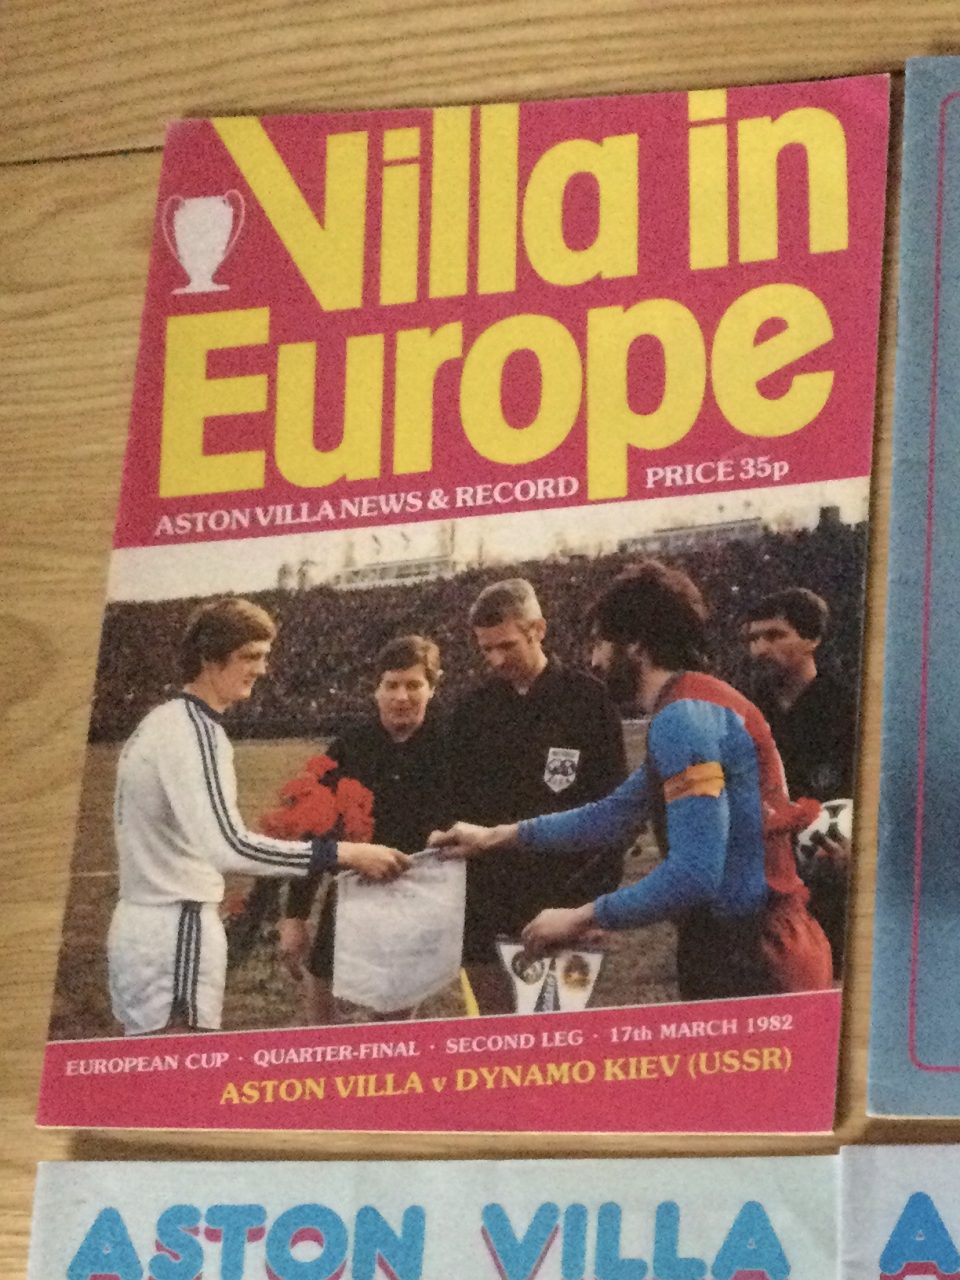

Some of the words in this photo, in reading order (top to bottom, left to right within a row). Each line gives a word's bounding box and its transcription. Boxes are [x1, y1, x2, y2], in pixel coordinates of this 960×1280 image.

[212, 102, 640, 311] Villa
[688, 89, 849, 271] in
[158, 283, 834, 501] Europe
[645, 460, 735, 488] PRICE
[739, 456, 789, 481] 35p
[154, 508, 250, 537] ASTON
[256, 499, 335, 526] VILLA
[340, 491, 423, 519] NEWS
[427, 488, 449, 511] &
[455, 476, 579, 508] RECORD
[65, 1055, 179, 1077] EUROPEAN
[185, 1052, 230, 1069] CUP
[253, 1041, 421, 1068] QUARTER-FINAL
[445, 1033, 536, 1054] SECOND
[542, 1029, 584, 1048] LEG
[609, 1025, 652, 1044] 17th
[660, 1018, 738, 1039] MARCH
[747, 1014, 794, 1034] 1982
[219, 1077, 326, 1106] ASTON
[334, 1071, 424, 1099] VILLA
[432, 1077, 447, 1093] v
[455, 1060, 596, 1093] DYNAMO
[603, 1054, 681, 1082] KIEV
[688, 1047, 793, 1080] (USSR)
